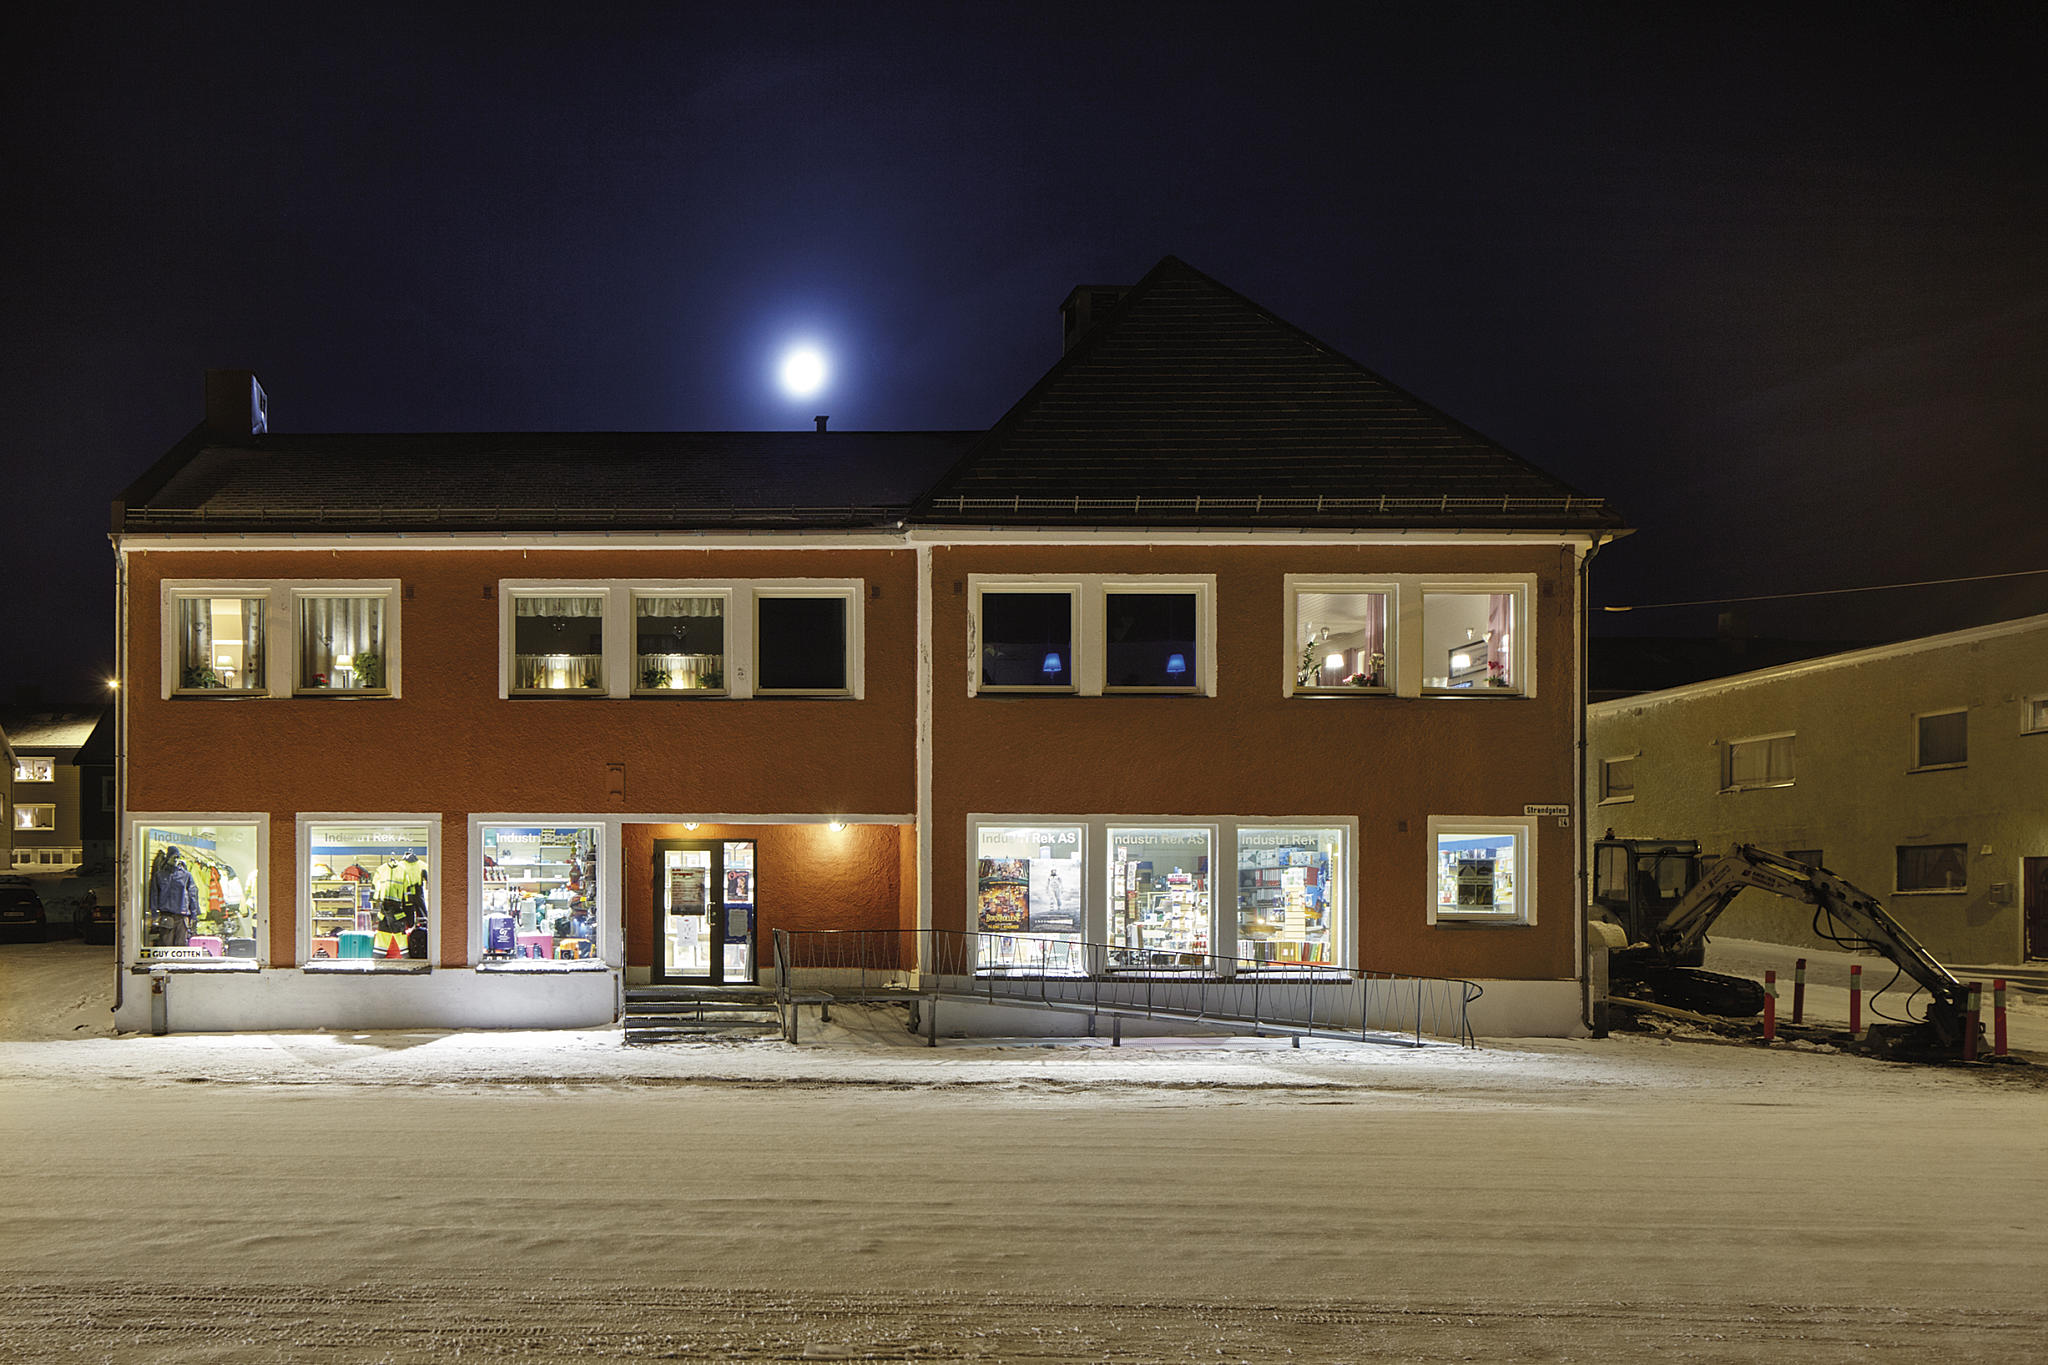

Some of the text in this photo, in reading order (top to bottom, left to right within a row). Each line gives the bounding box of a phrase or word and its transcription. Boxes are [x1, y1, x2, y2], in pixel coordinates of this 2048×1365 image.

[1032, 832, 1057, 844] Rek
[1058, 833, 1076, 844] AS
[1113, 833, 1158, 844] ndustri
[1187, 833, 1205, 844] AS
[1241, 834, 1289, 845] Industri
[1292, 834, 1317, 845] Rek
[152, 950, 201, 958] GUY COTTEN
